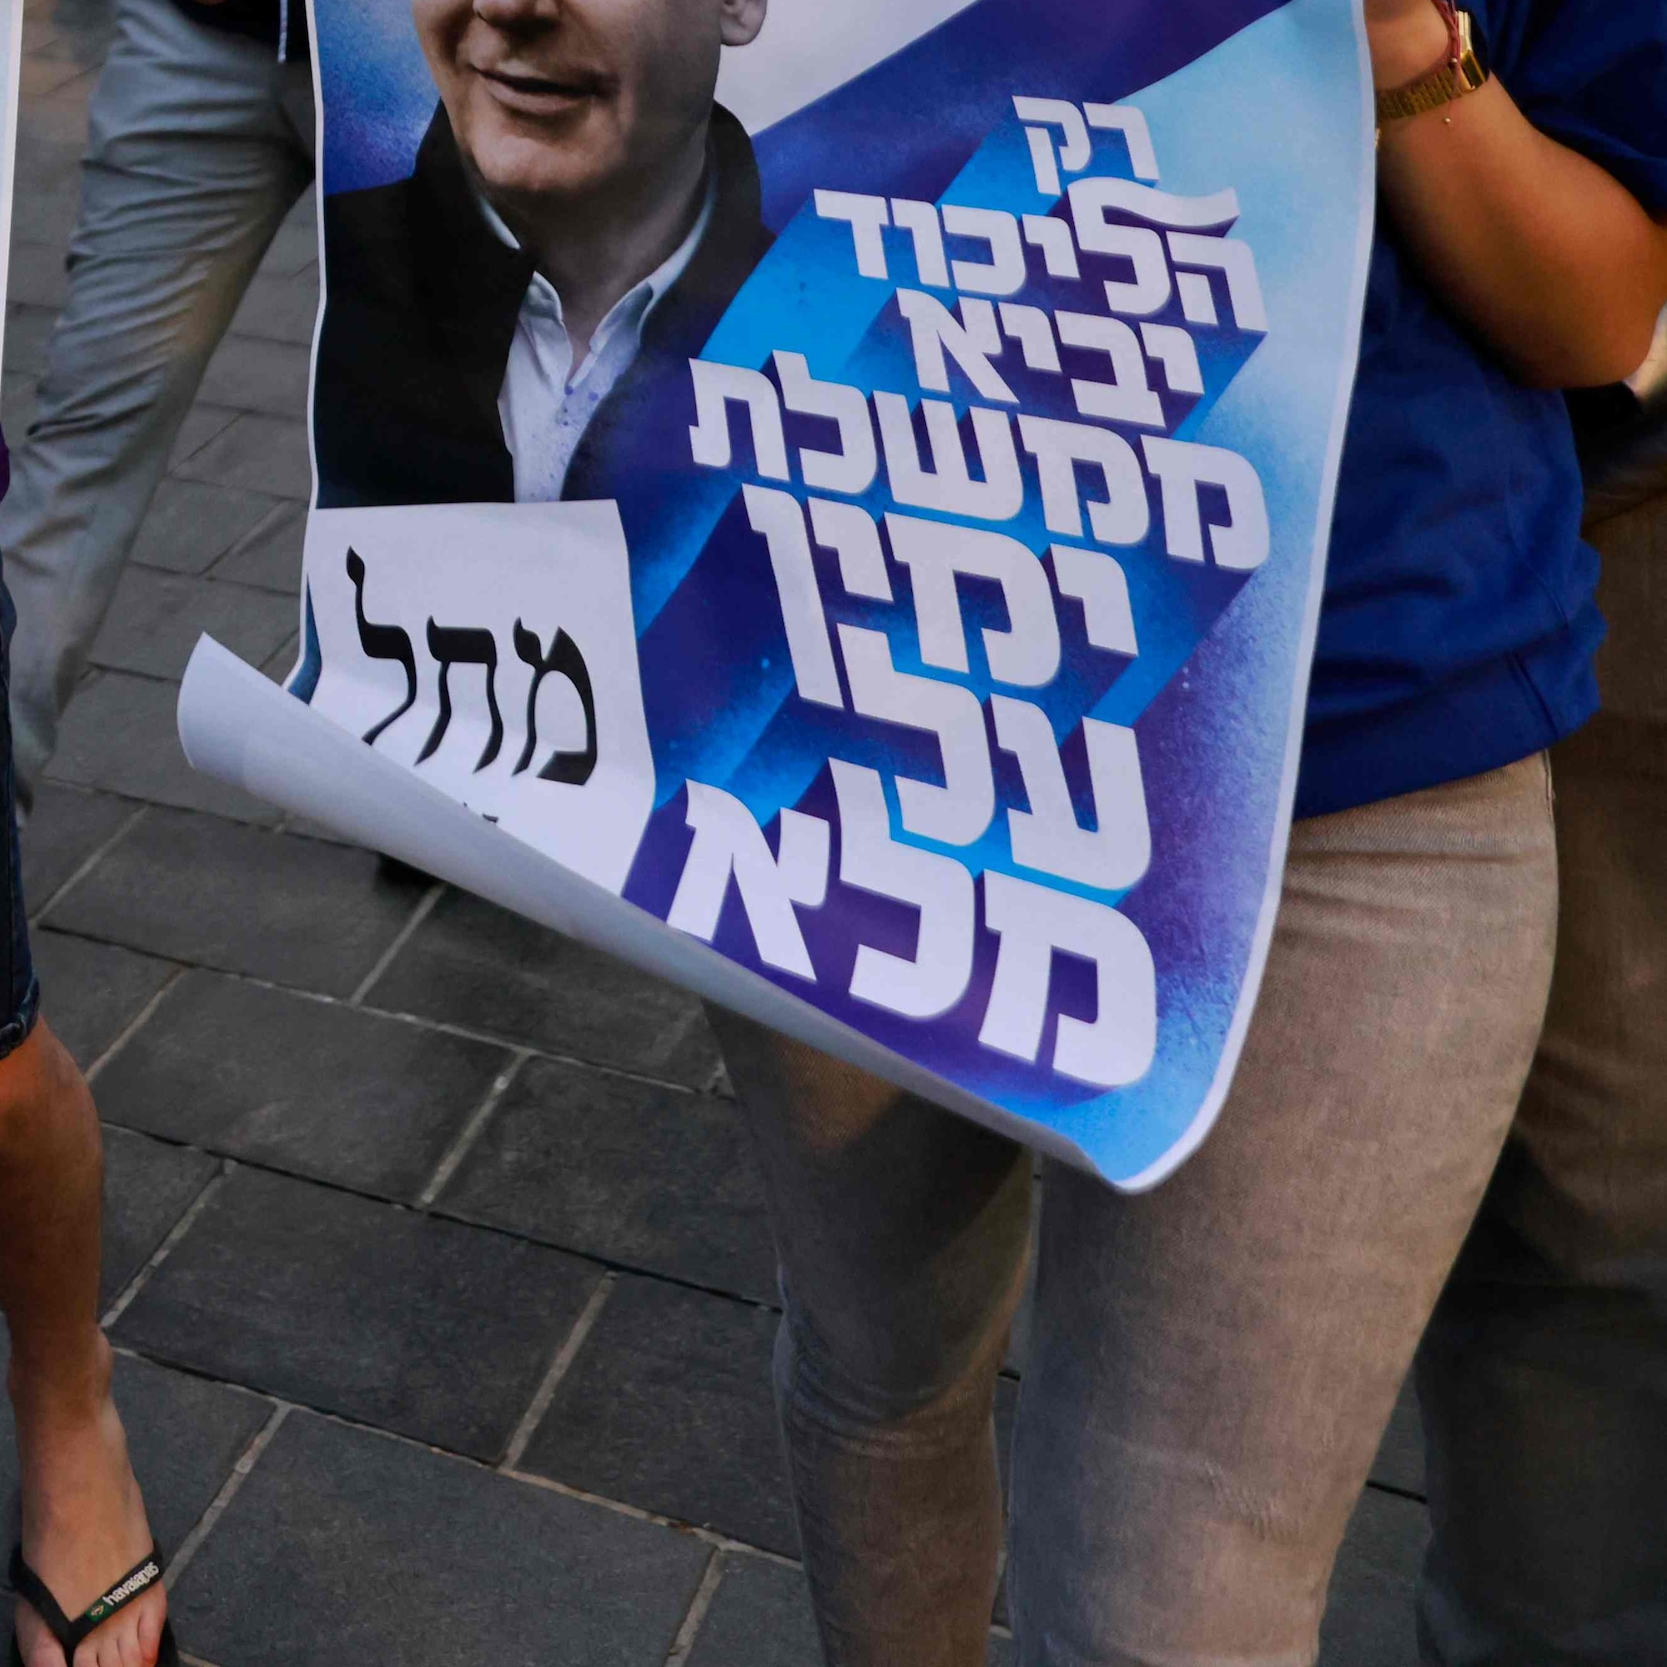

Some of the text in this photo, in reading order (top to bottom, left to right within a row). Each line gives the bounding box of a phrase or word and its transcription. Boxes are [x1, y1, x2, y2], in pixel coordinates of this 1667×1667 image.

[814, 178, 1268, 332] הליכוד
[1013, 95, 1159, 196] רק
[689, 349, 1268, 571] ממשלת
[897, 287, 1204, 429] יביא
[346, 545, 597, 785] מחל
[742, 482, 1140, 710] ימין
[835, 622, 1152, 891] על
[666, 756, 1157, 1087] מלא
